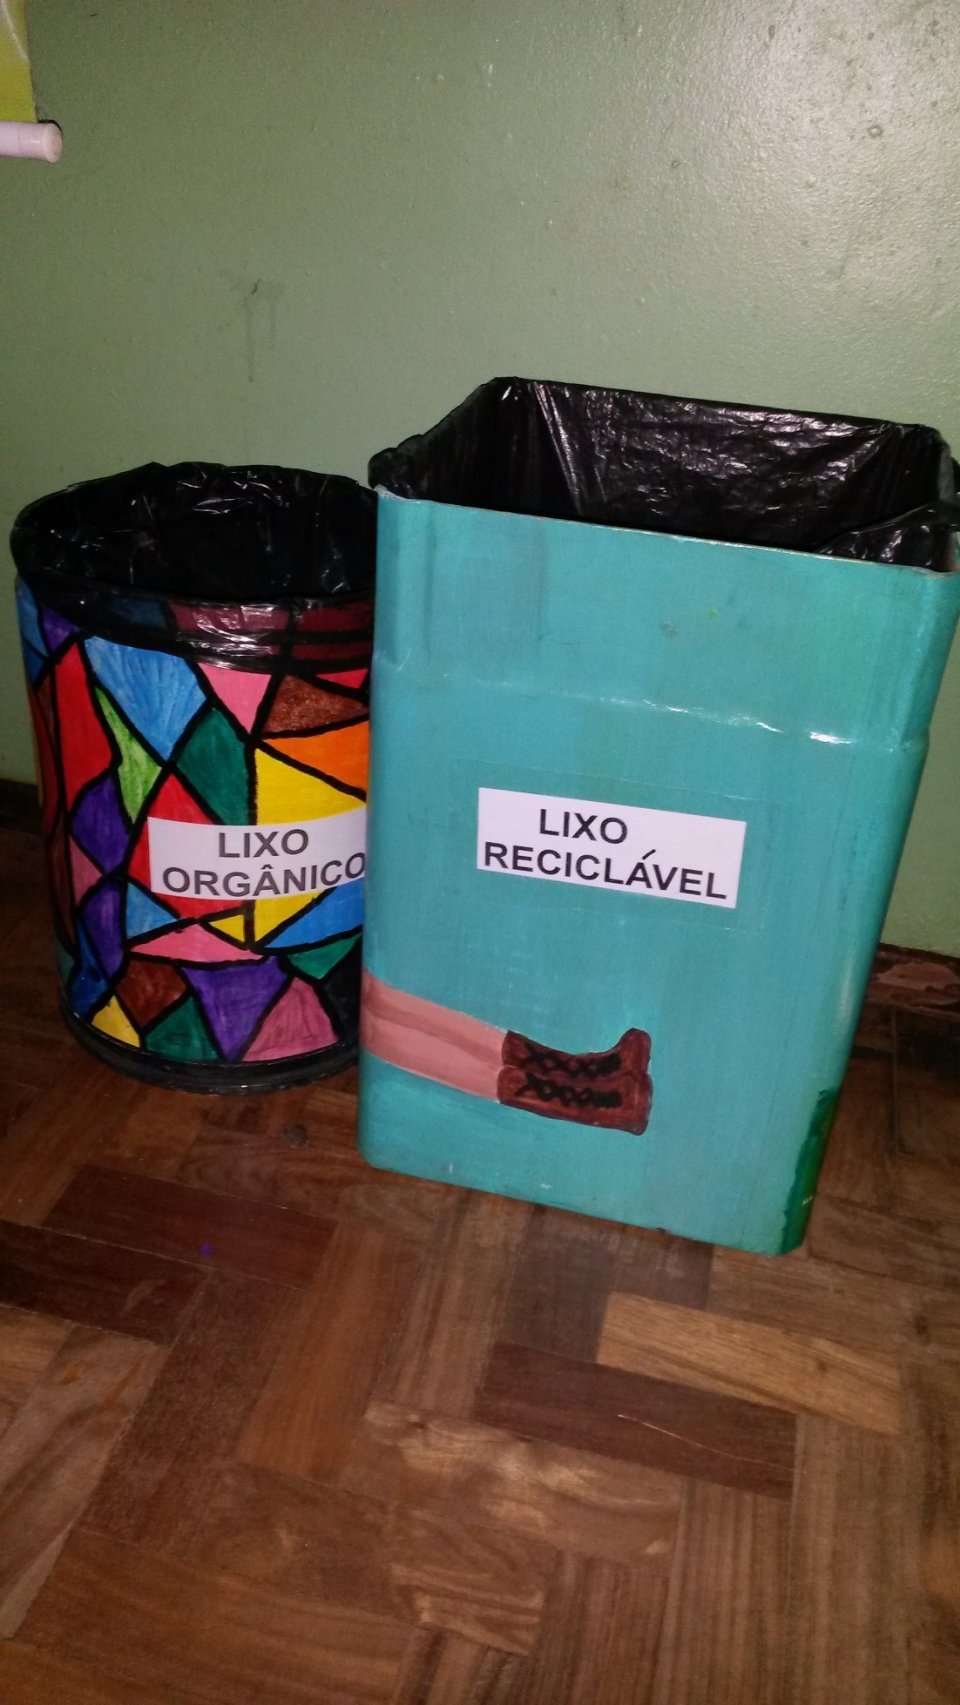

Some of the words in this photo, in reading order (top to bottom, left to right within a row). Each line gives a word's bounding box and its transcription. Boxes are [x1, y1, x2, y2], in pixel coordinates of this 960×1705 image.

[218, 828, 309, 858] LIXO
[539, 808, 628, 845] LIXO
[162, 852, 366, 897] ORGÂNICO
[484, 841, 727, 900] RECICLÁVEL
